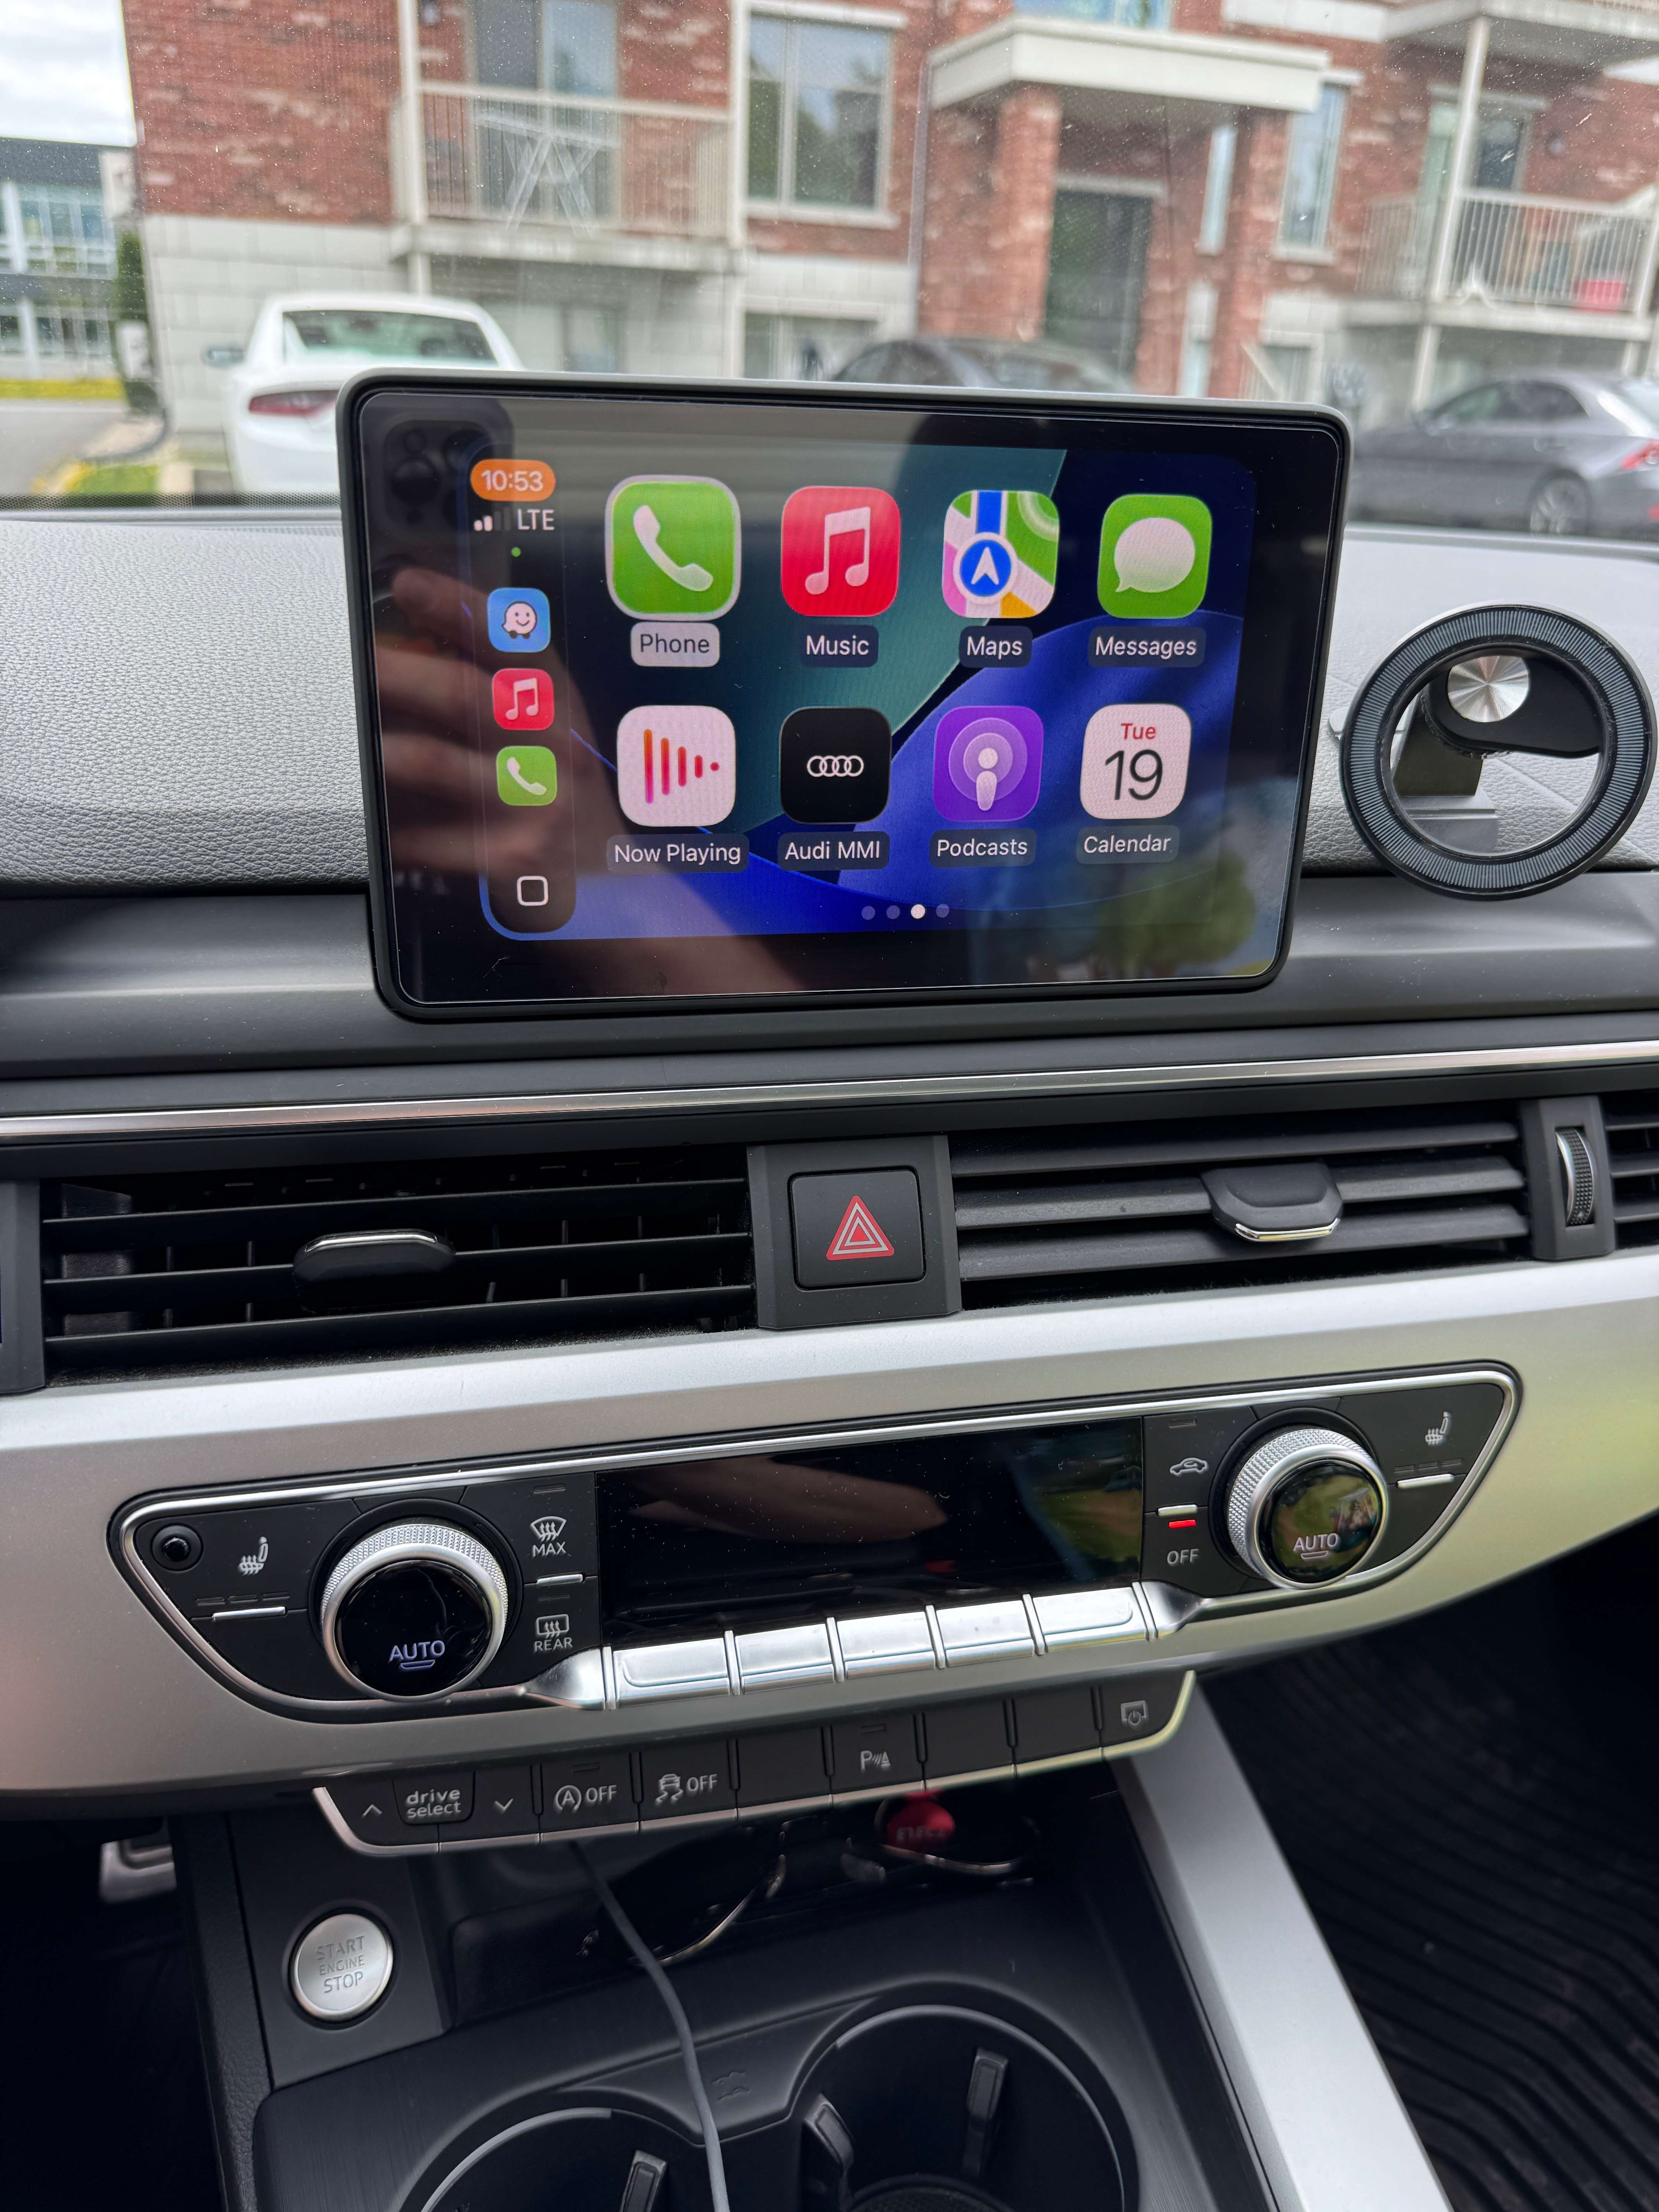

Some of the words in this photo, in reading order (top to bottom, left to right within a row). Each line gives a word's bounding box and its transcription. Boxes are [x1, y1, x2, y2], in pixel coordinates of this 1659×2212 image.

[481, 469, 544, 492] 10:53
[517, 508, 555, 531] LTE
[640, 634, 710, 653] Phone
[806, 635, 869, 656] Music
[967, 636, 1023, 659] Maps
[1096, 637, 1197, 660] Messages
[1121, 723, 1156, 740] Tue
[1104, 749, 1163, 801] 19
[614, 844, 661, 863] Now
[666, 843, 741, 865] Playing
[785, 841, 830, 860] Audi
[838, 841, 880, 859] MMI
[937, 839, 1028, 857] Podcasts
[1084, 835, 1171, 854] Calendar
[532, 1541, 566, 1557] MAX
[1293, 1532, 1340, 1550] AUTO
[1167, 1549, 1199, 1565] OFF
[388, 1640, 445, 1662] AUTO
[534, 1637, 573, 1651] REAR
[687, 1774, 718, 1792] OFF
[407, 1788, 461, 1806] drive
[586, 1784, 617, 1802] OFF
[407, 1802, 461, 1819] select
[316, 1936, 365, 1961] START
[319, 1954, 366, 1975] ENGINE
[323, 1971, 364, 1993] STOP
